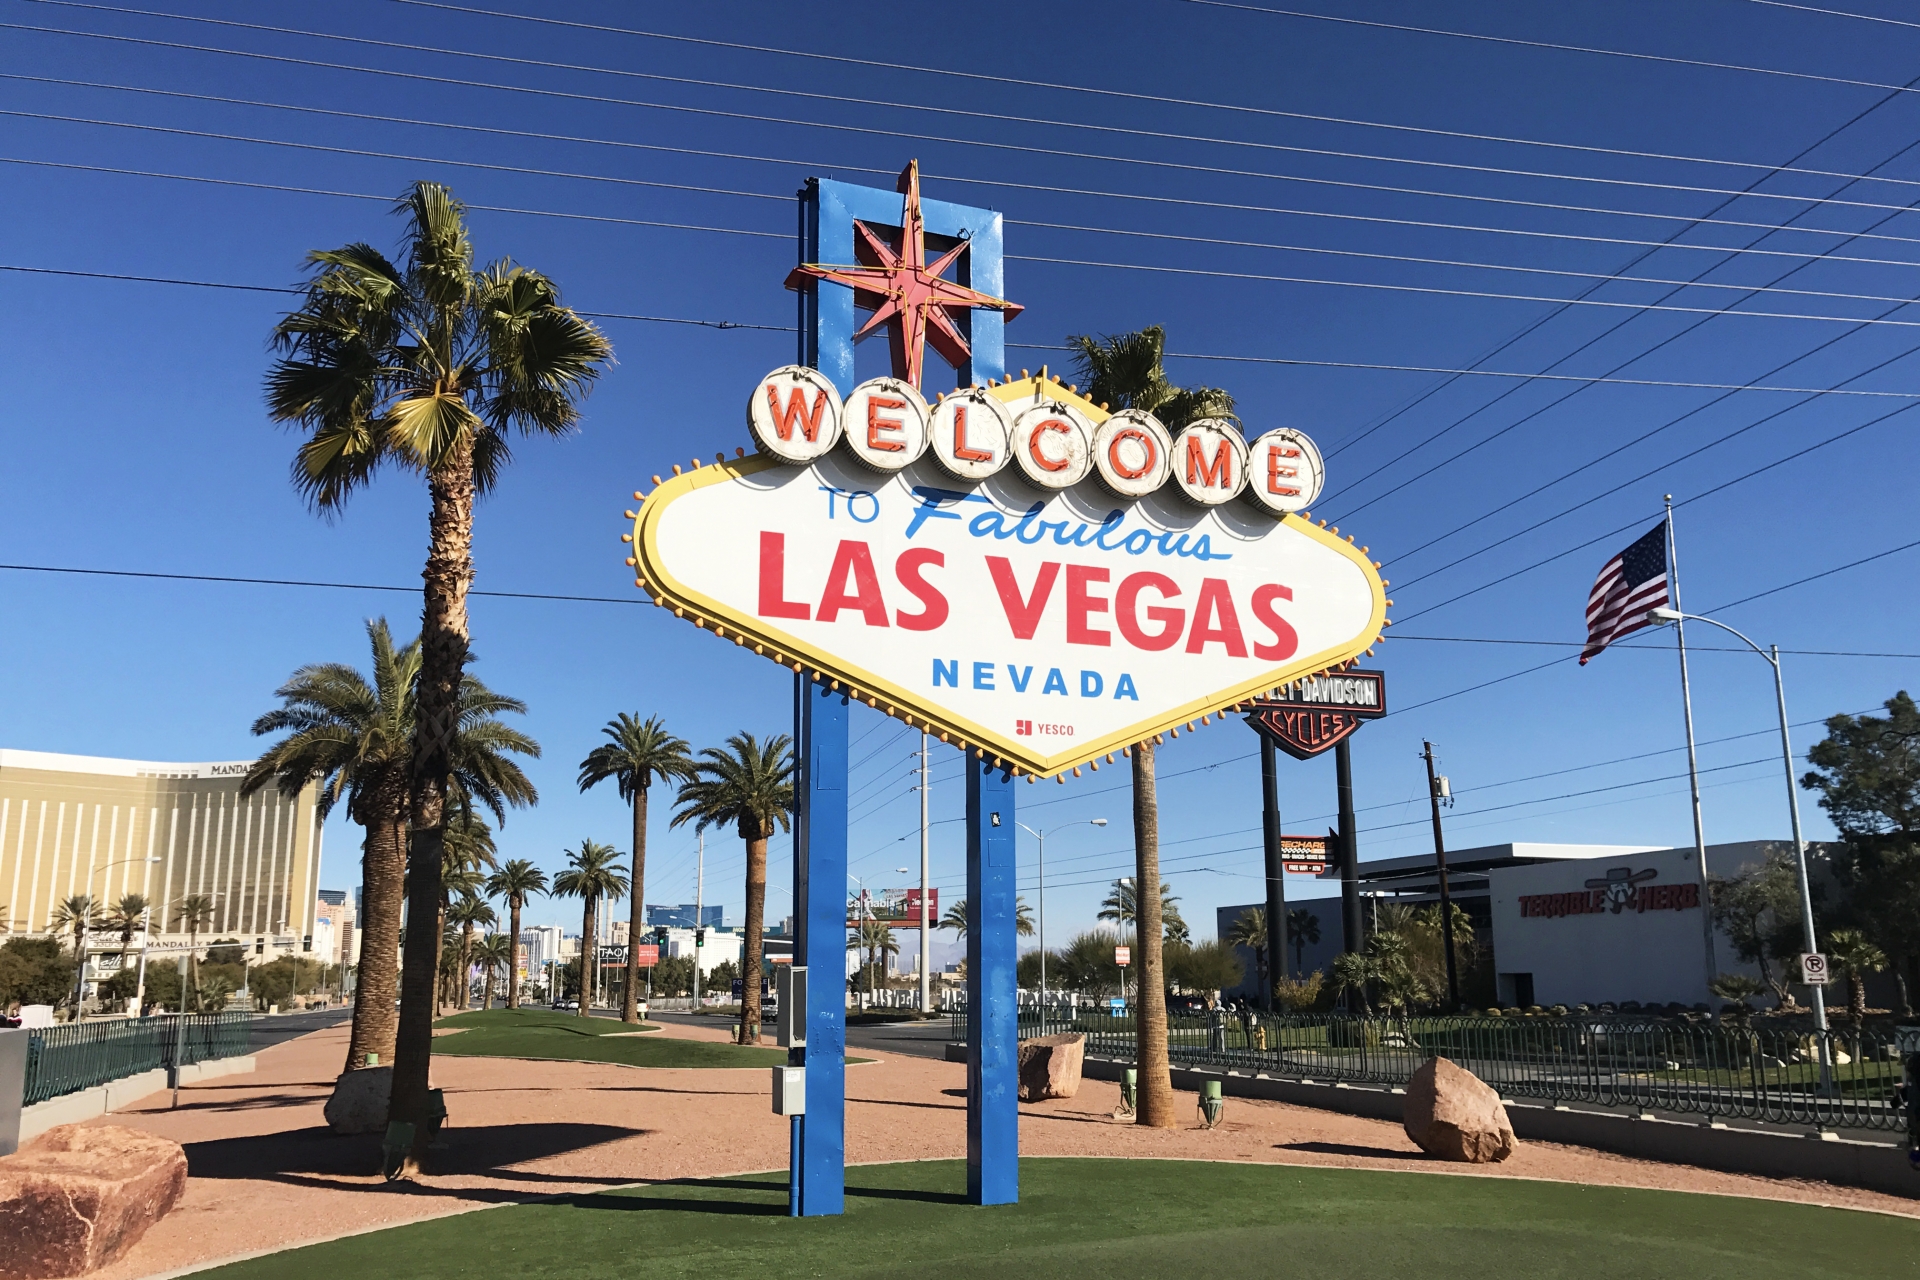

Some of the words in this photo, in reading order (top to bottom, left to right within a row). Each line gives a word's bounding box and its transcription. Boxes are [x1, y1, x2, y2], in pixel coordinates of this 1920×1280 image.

[767, 384, 1301, 496] WELCOME
[818, 486, 880, 522] TO
[905, 485, 1233, 561] Fabulous
[757, 530, 950, 632] LAS
[984, 555, 1299, 662] VEGAS
[932, 658, 1140, 702] NEVADA
[1037, 723, 1074, 736] YESCO
[1272, 711, 1344, 745] CYCLES
[1518, 890, 1605, 918] TERRIBLE
[1637, 884, 1701, 913] HERB
[600, 947, 623, 957] TAO
